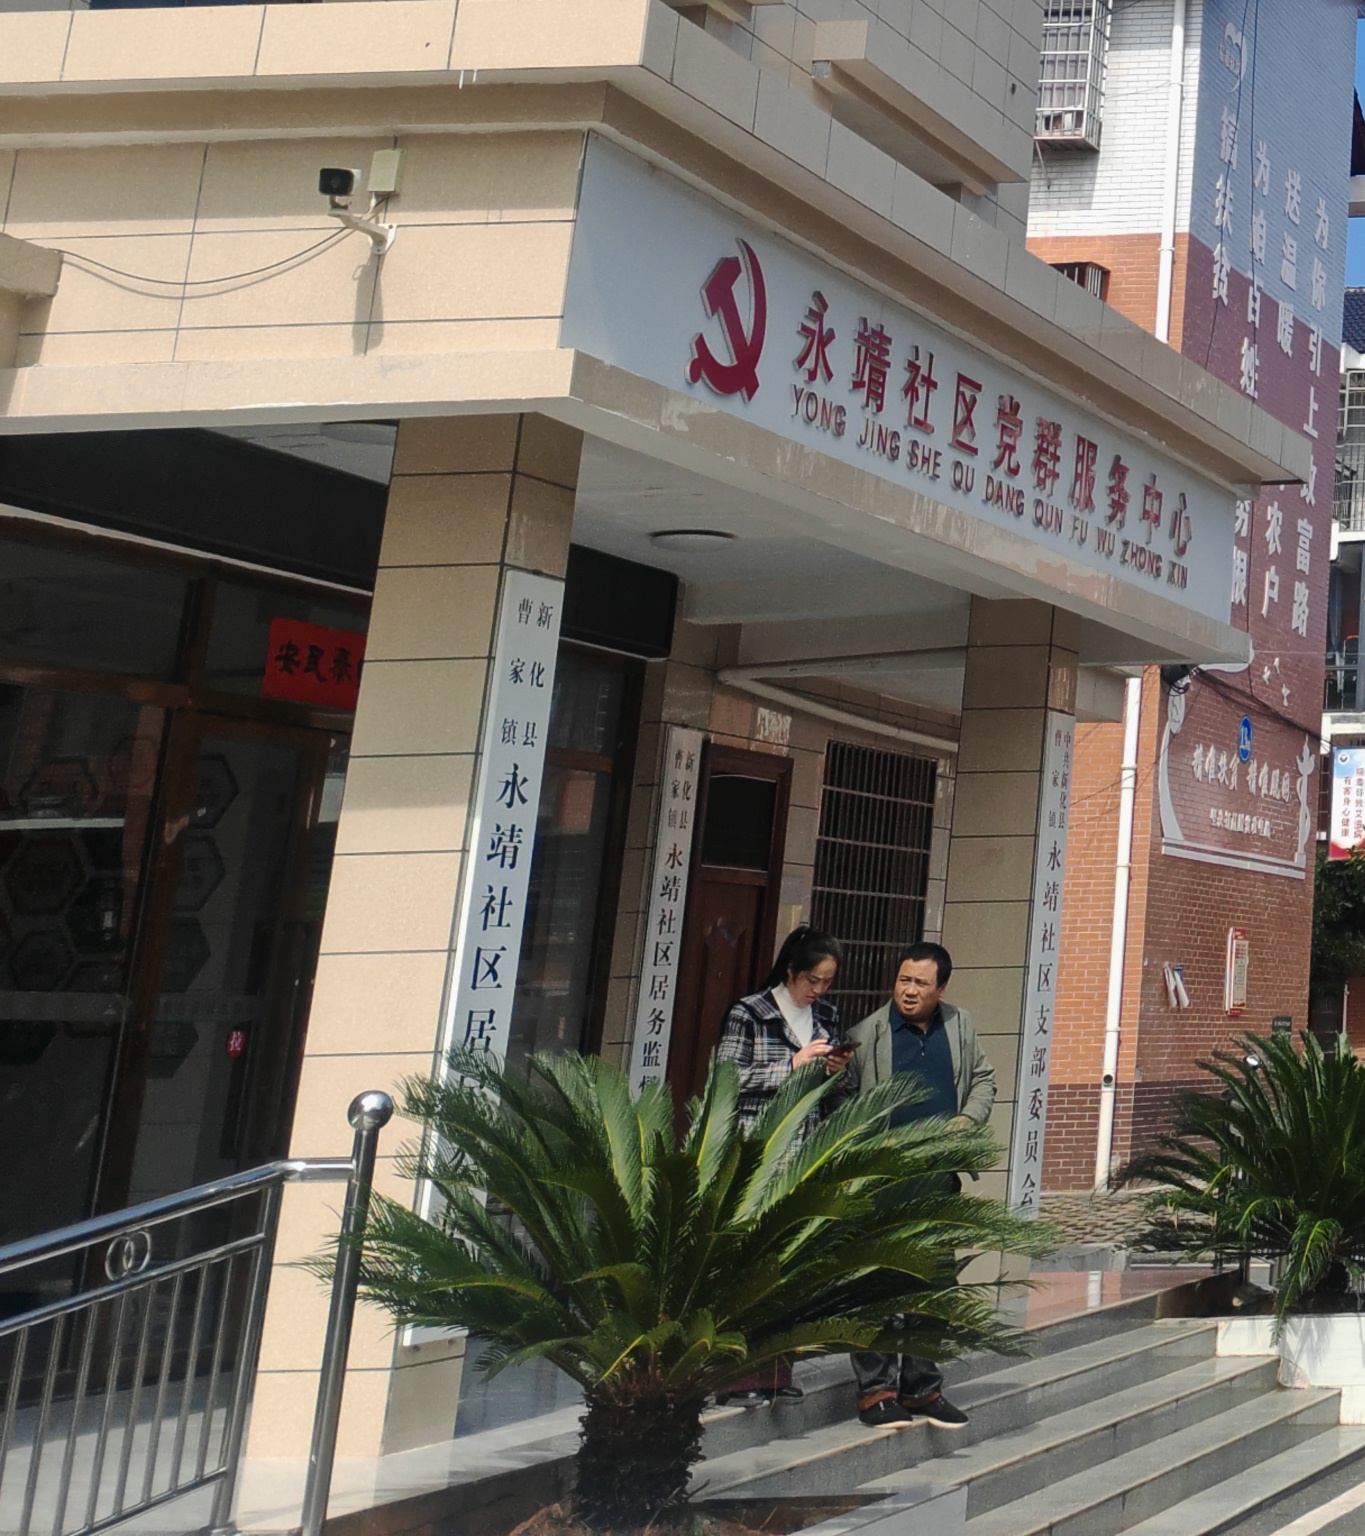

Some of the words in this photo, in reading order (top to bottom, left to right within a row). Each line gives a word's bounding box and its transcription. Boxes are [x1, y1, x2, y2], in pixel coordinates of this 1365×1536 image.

[790, 383, 847, 438] YONG
[857, 424, 900, 461] JING
[907, 442, 941, 480] SHE
[951, 461, 977, 494] QU
[983, 474, 1025, 517] DANG
[1033, 497, 1063, 533] QUN
[1072, 516, 1088, 546] FU
[1095, 529, 1116, 559] WU
[1120, 539, 1163, 579] ZHONG
[1167, 562, 1189, 590] XIN
[792, 290, 1193, 558] 永靖社区党群服务中心
[501, 597, 534, 746] 曹家镇
[522, 600, 554, 748] 新化县
[1020, 840, 1062, 1207] 永靖社区支部委员会
